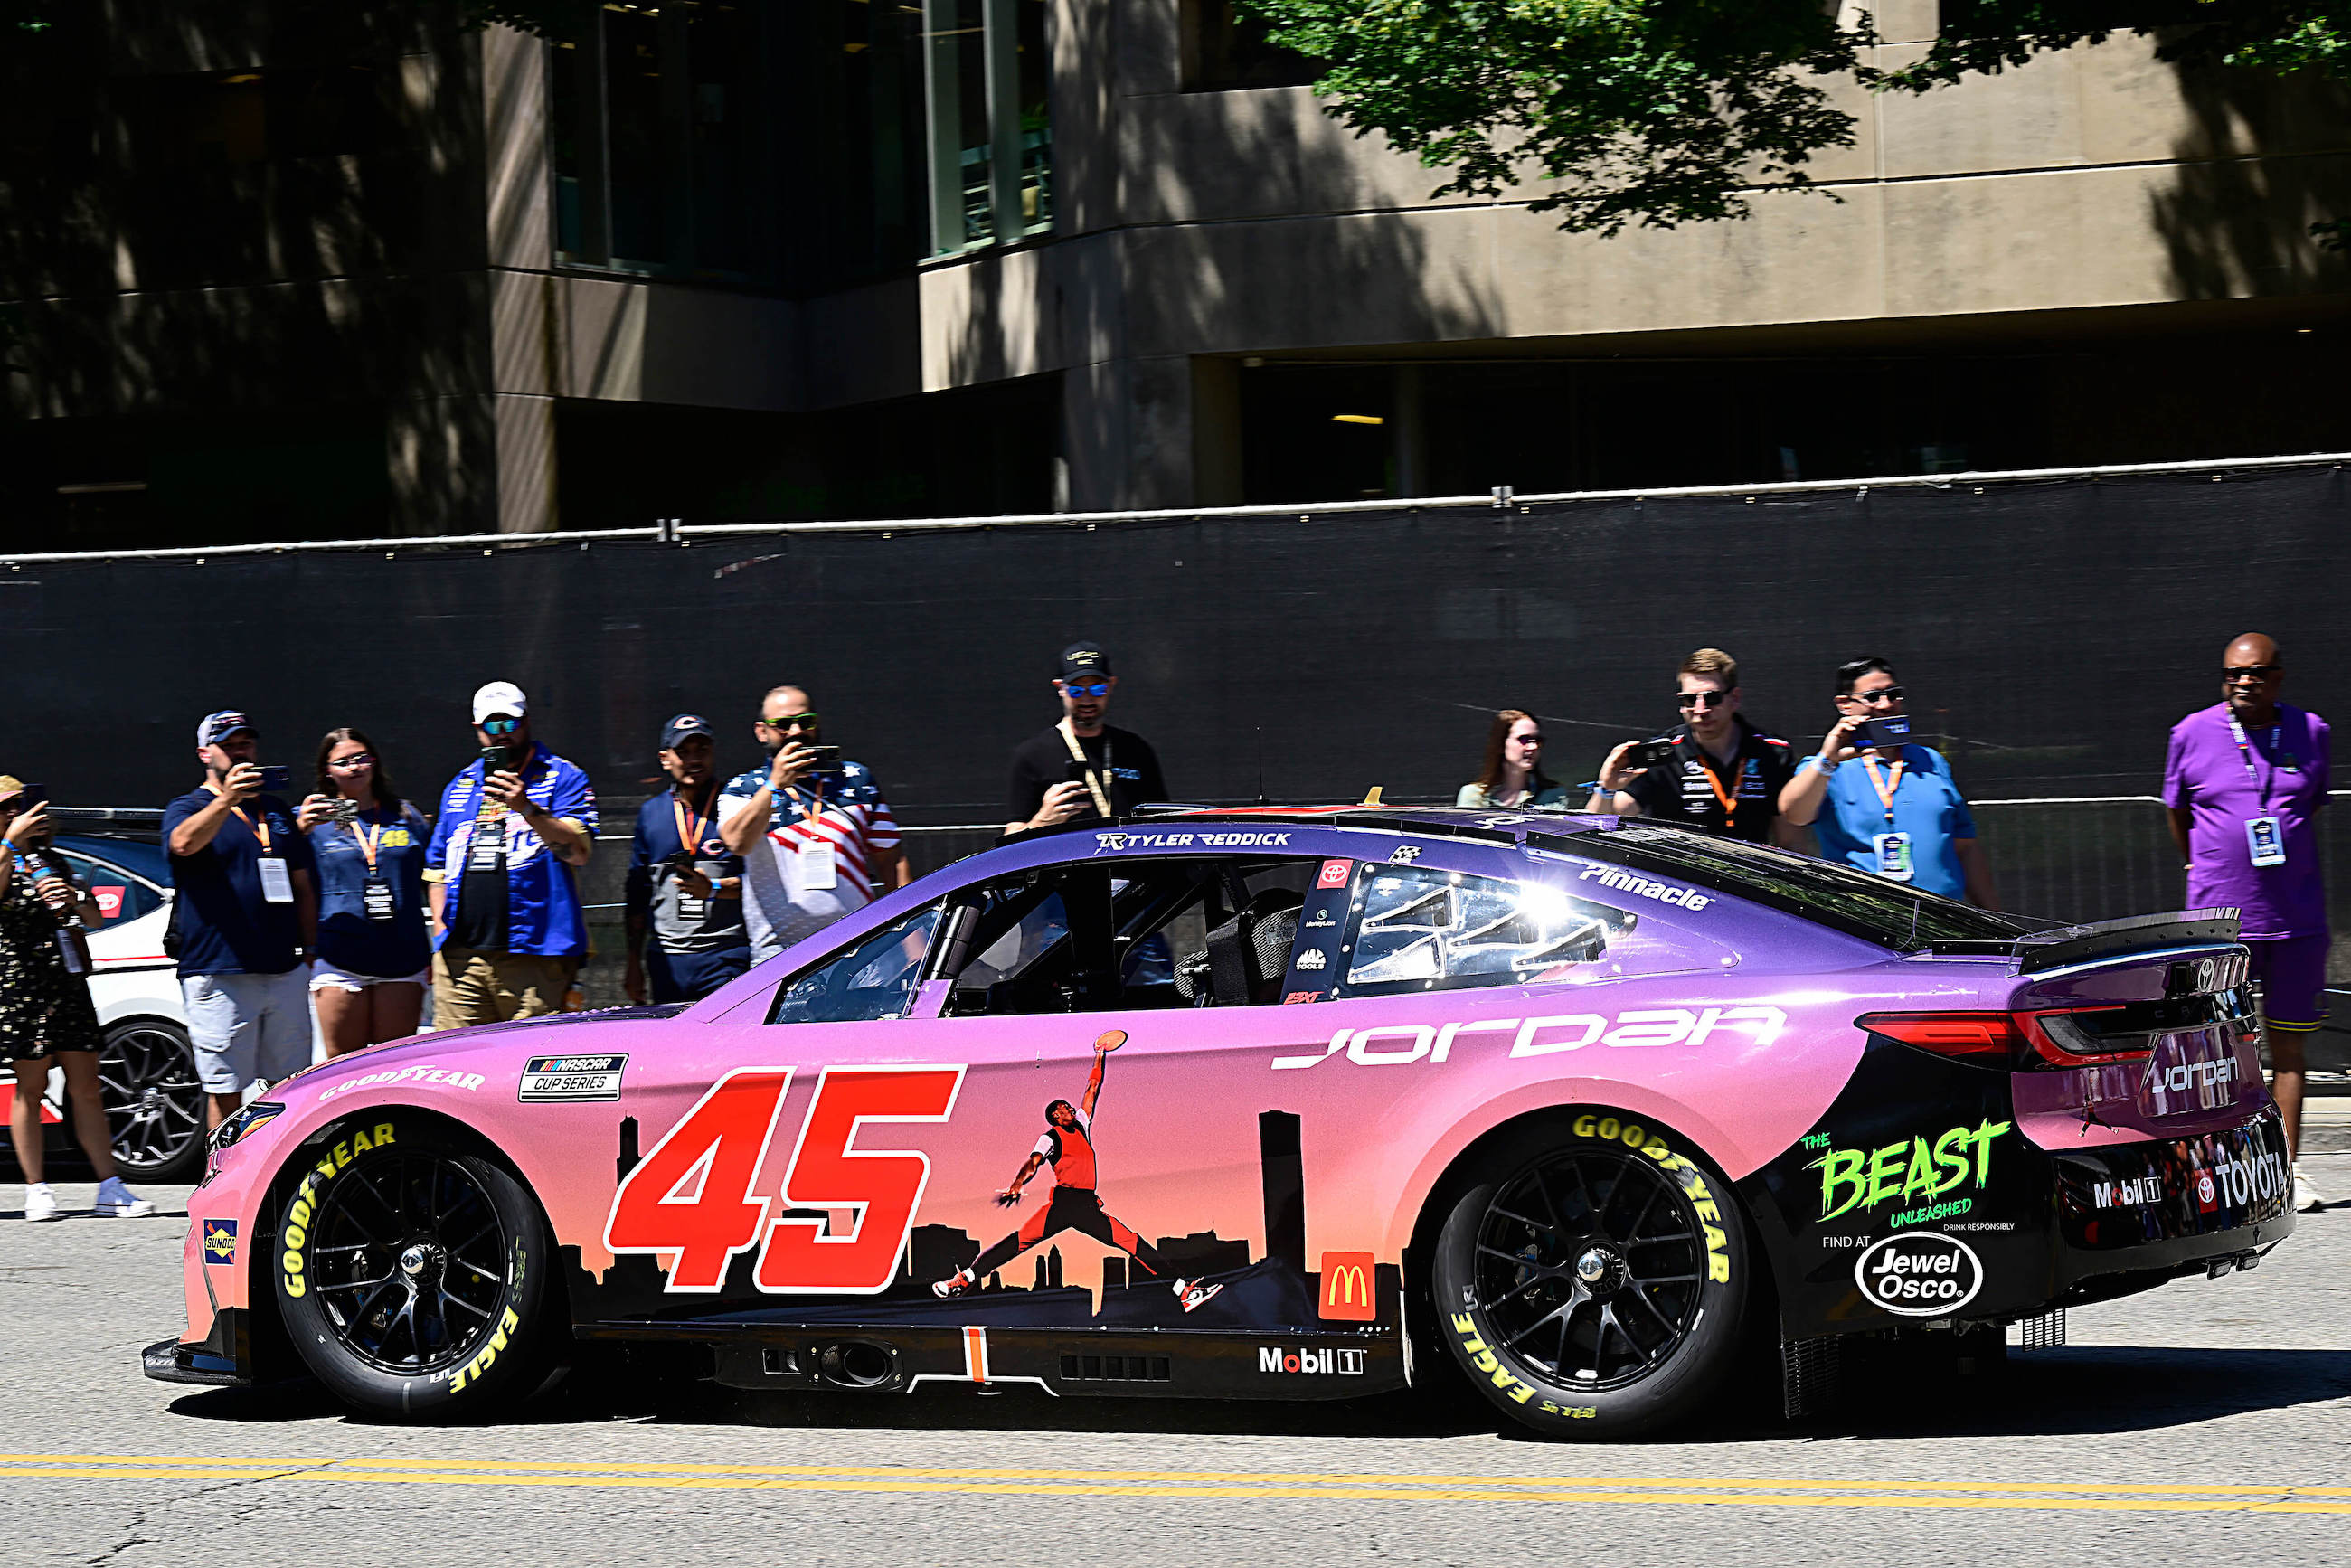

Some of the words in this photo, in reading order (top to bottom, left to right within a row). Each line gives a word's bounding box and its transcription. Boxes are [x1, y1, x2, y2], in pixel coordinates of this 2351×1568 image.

[1128, 834, 1194, 846] TYLER
[1197, 833, 1291, 845] REDDICK
[1579, 862, 1708, 912] Pinnacle
[1296, 948, 1327, 964] MAC
[557, 1057, 612, 1072] NASCAR
[318, 1065, 486, 1100] GOODYEAR
[534, 1077, 560, 1091] CUP
[562, 1076, 607, 1090] SERIES
[1801, 1132, 1831, 1150] THE
[603, 1064, 968, 1294] 45
[1802, 1118, 2012, 1223] BEAST
[2215, 1151, 2287, 1209] TOYOTA
[1572, 1115, 1729, 1284] GOODYEAR
[2094, 1178, 2144, 1209] Mobil
[282, 1122, 396, 1299] GOODYEAR
[1891, 1198, 1972, 1228] UNLEASHED
[1823, 1236, 1853, 1248] FIND
[1855, 1235, 1872, 1248] AT
[1943, 1223, 1966, 1232] DRINK
[1967, 1223, 2015, 1231] RESPONSIBLY
[206, 1237, 235, 1249] SUNOCO
[1872, 1248, 1960, 1274] Jewel
[448, 1305, 519, 1394] EAGLE
[1259, 1347, 1334, 1373] Mobil
[1450, 1312, 1537, 1404] EAGLE
